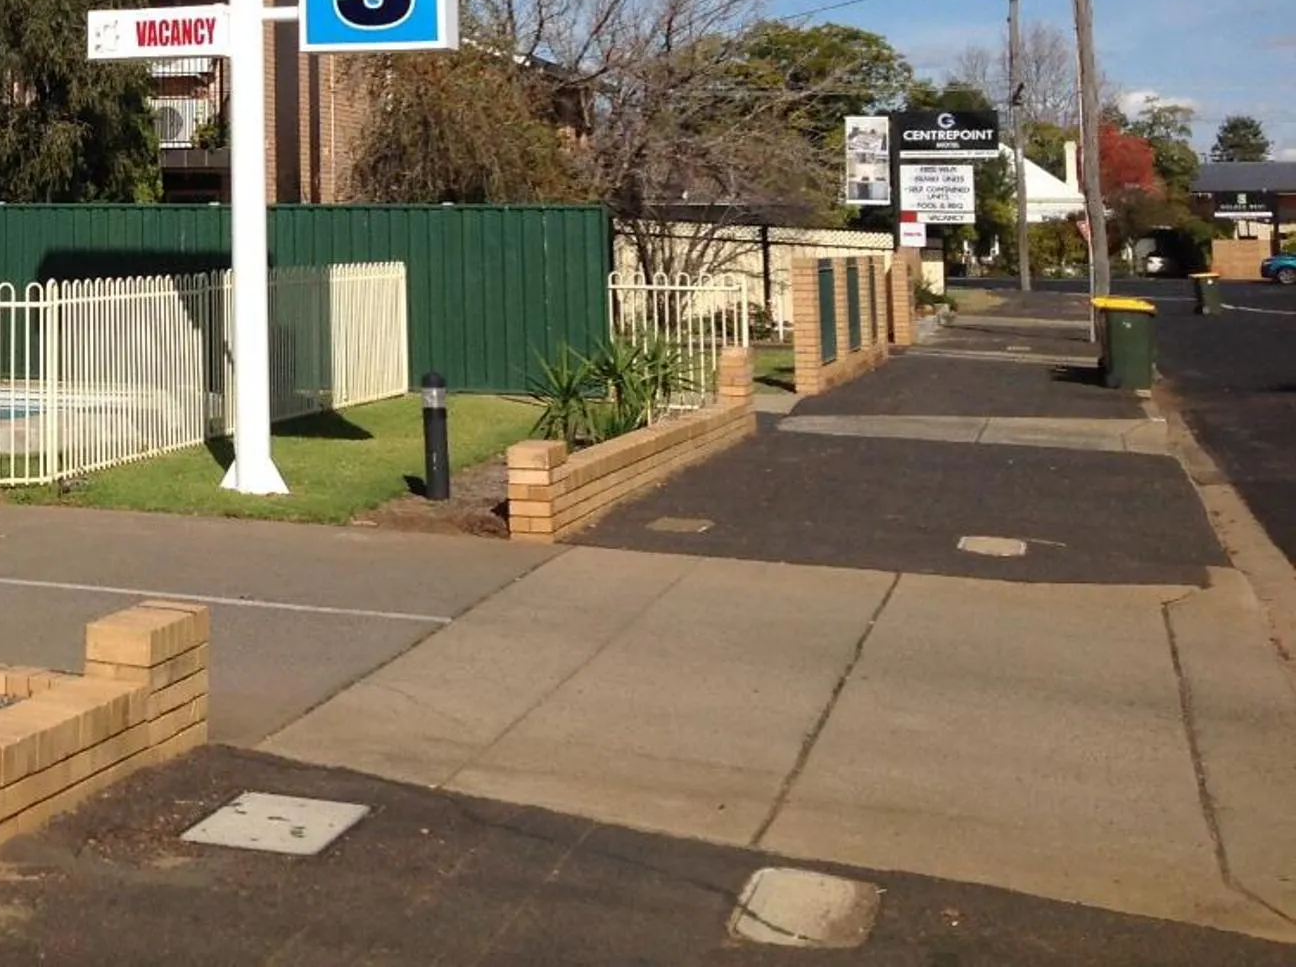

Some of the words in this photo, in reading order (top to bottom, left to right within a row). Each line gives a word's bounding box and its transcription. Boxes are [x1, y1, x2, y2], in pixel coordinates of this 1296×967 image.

[136, 17, 216, 47] VACANCY
[903, 129, 994, 141] CENTREPOINT
[928, 214, 964, 222] VACANCY
